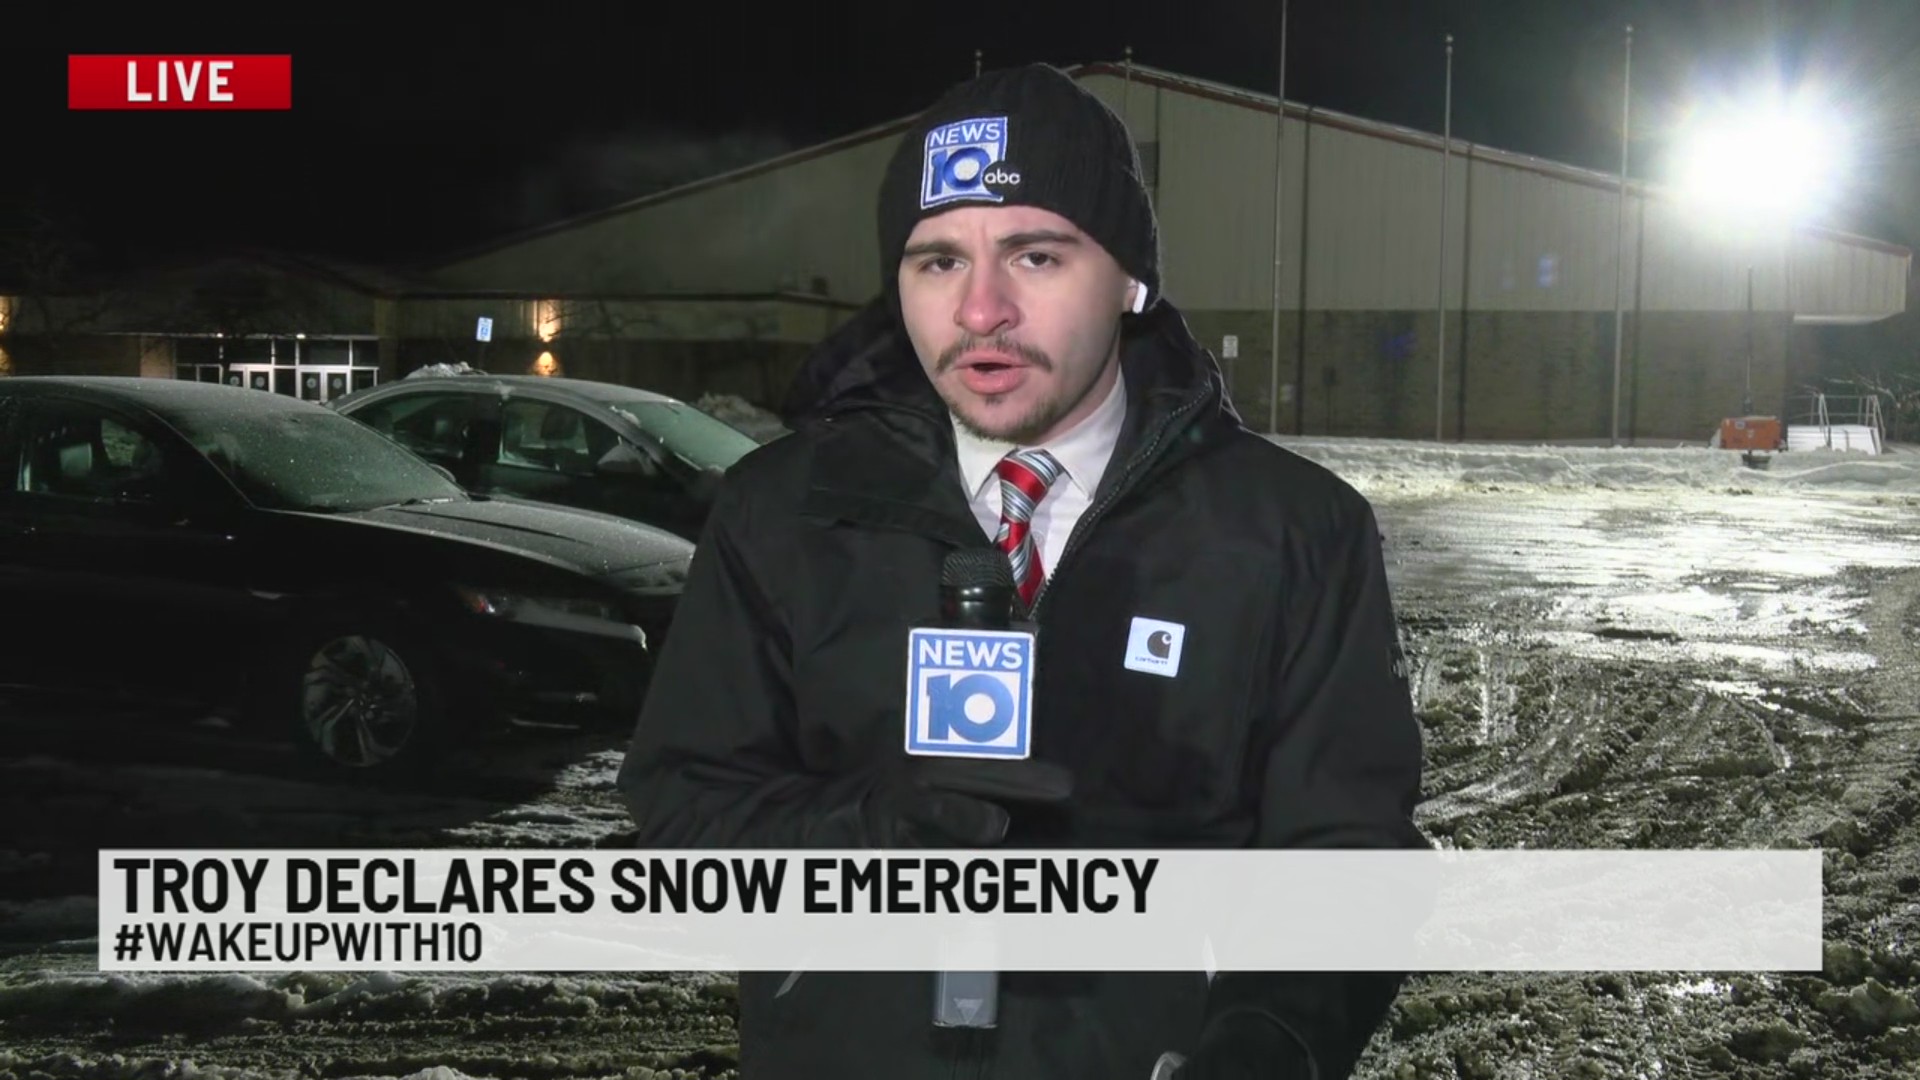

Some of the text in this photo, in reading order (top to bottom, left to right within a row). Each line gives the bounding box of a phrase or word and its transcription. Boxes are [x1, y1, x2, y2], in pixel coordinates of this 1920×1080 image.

[929, 123, 1000, 147] NEWS
[930, 147, 992, 196] 10
[984, 168, 1021, 185] abc
[919, 639, 1022, 669] NEWS
[926, 673, 1015, 743] 10
